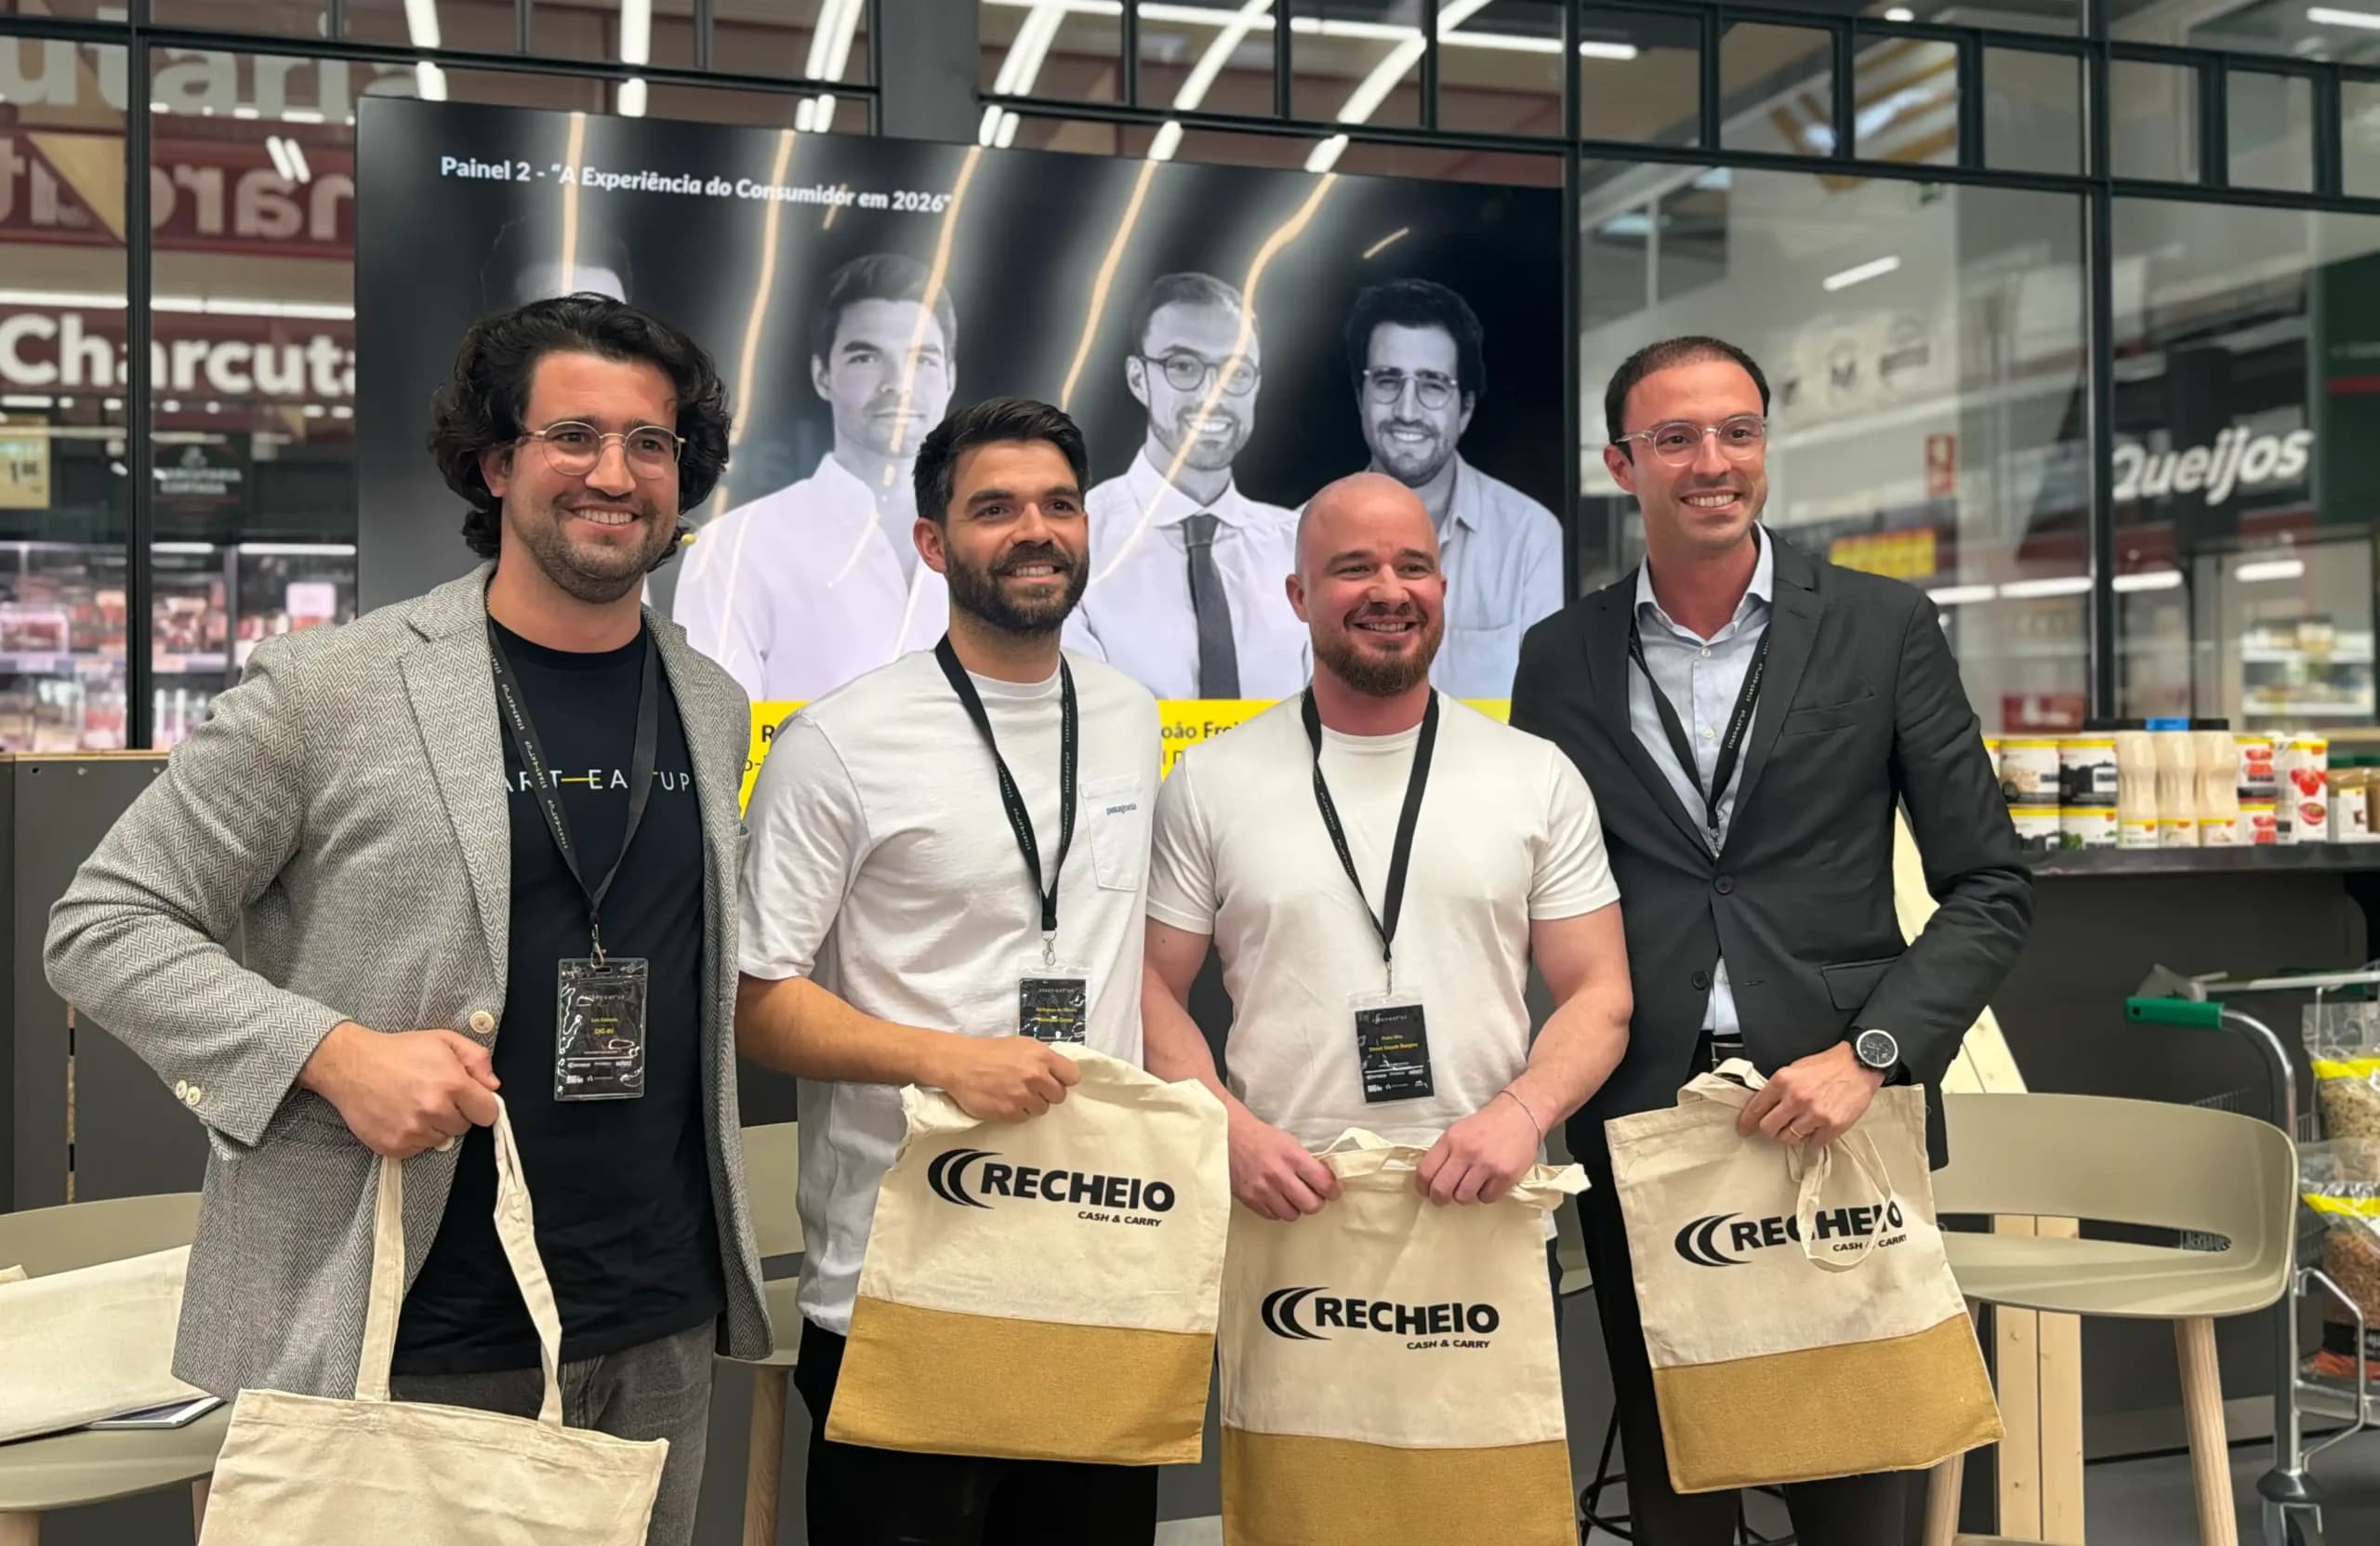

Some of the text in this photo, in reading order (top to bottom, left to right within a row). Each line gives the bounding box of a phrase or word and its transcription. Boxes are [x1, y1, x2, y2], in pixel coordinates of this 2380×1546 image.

[441, 155, 510, 180] Painel
[516, 161, 531, 181] 2
[581, 165, 702, 194] Experiência
[705, 176, 732, 197] do
[735, 178, 855, 206] Consumidor
[858, 192, 888, 209] em
[980, 1163, 1175, 1212] RECHEIO
[1078, 1210, 1162, 1228] CASH & CARRY
[1832, 1241, 1863, 1252] CASH
[1315, 1297, 1500, 1336] RECHEIO
[1407, 1341, 1437, 1350] CASH
[1452, 1340, 1490, 1349] CARRY
